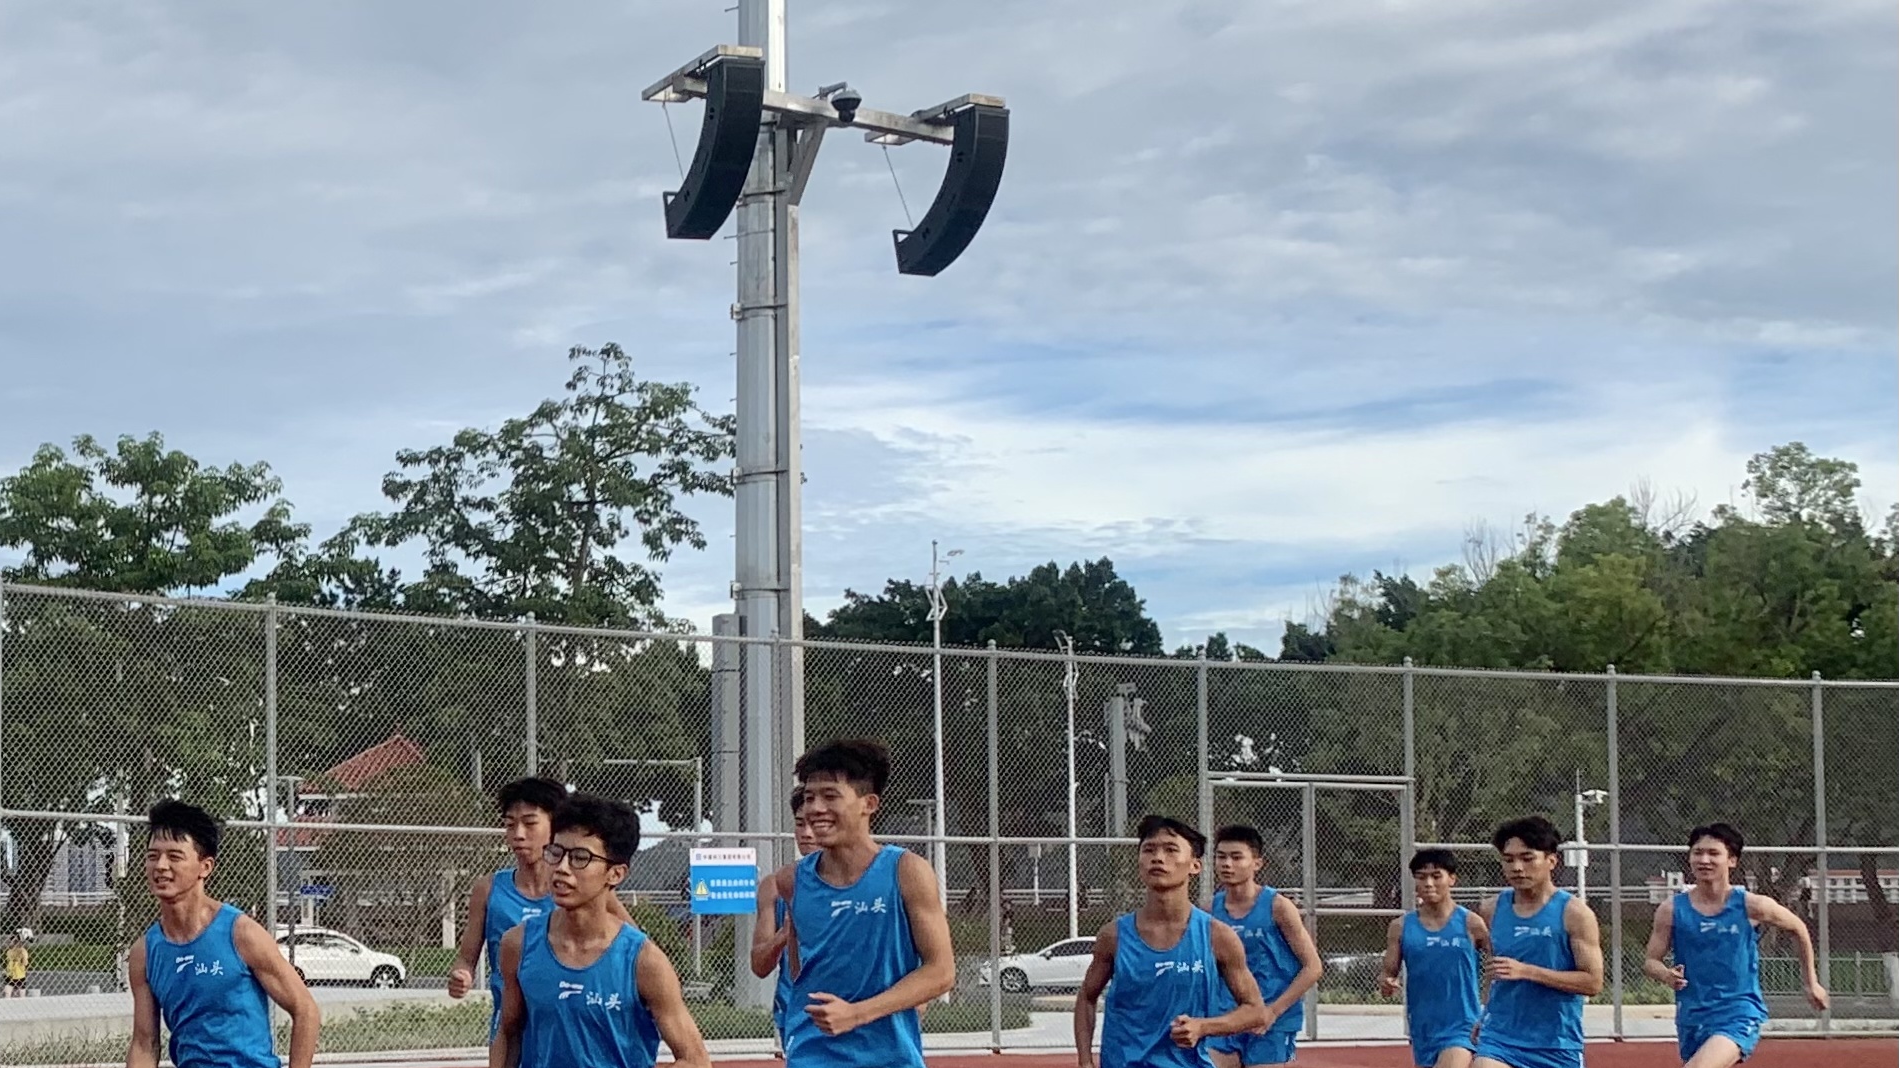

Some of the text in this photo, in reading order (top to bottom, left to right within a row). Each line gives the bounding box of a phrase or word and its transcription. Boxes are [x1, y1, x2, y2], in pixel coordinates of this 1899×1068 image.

[854, 896, 887, 915] 汕头
[194, 959, 224, 976] 汕头
[585, 990, 622, 1012] 汕头
